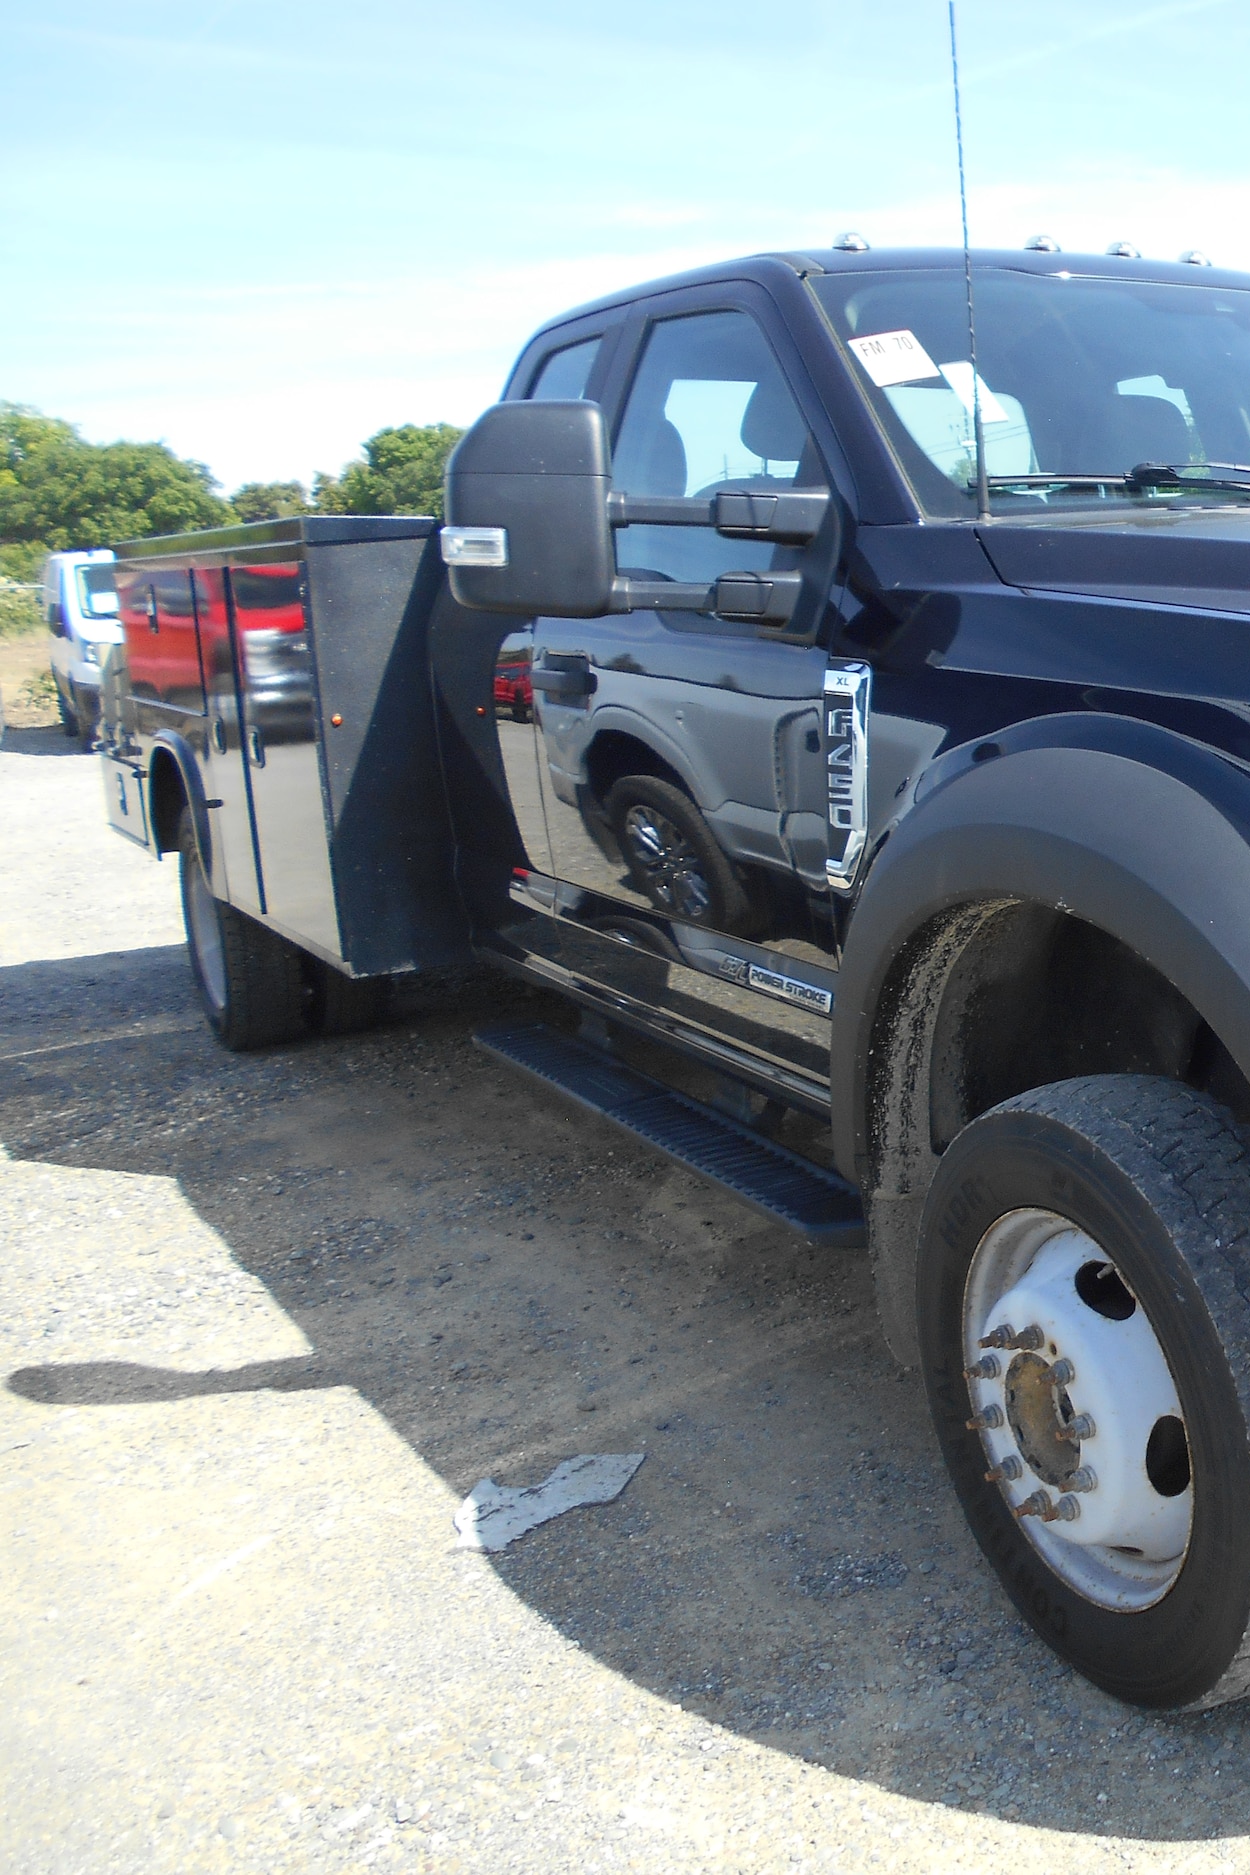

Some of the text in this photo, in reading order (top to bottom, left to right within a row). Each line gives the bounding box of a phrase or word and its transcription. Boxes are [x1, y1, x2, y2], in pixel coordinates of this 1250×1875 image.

[860, 336, 914, 357] FM 70
[836, 676, 850, 686] XL
[749, 968, 785, 991] POWER
[785, 981, 828, 1006] STROKE
